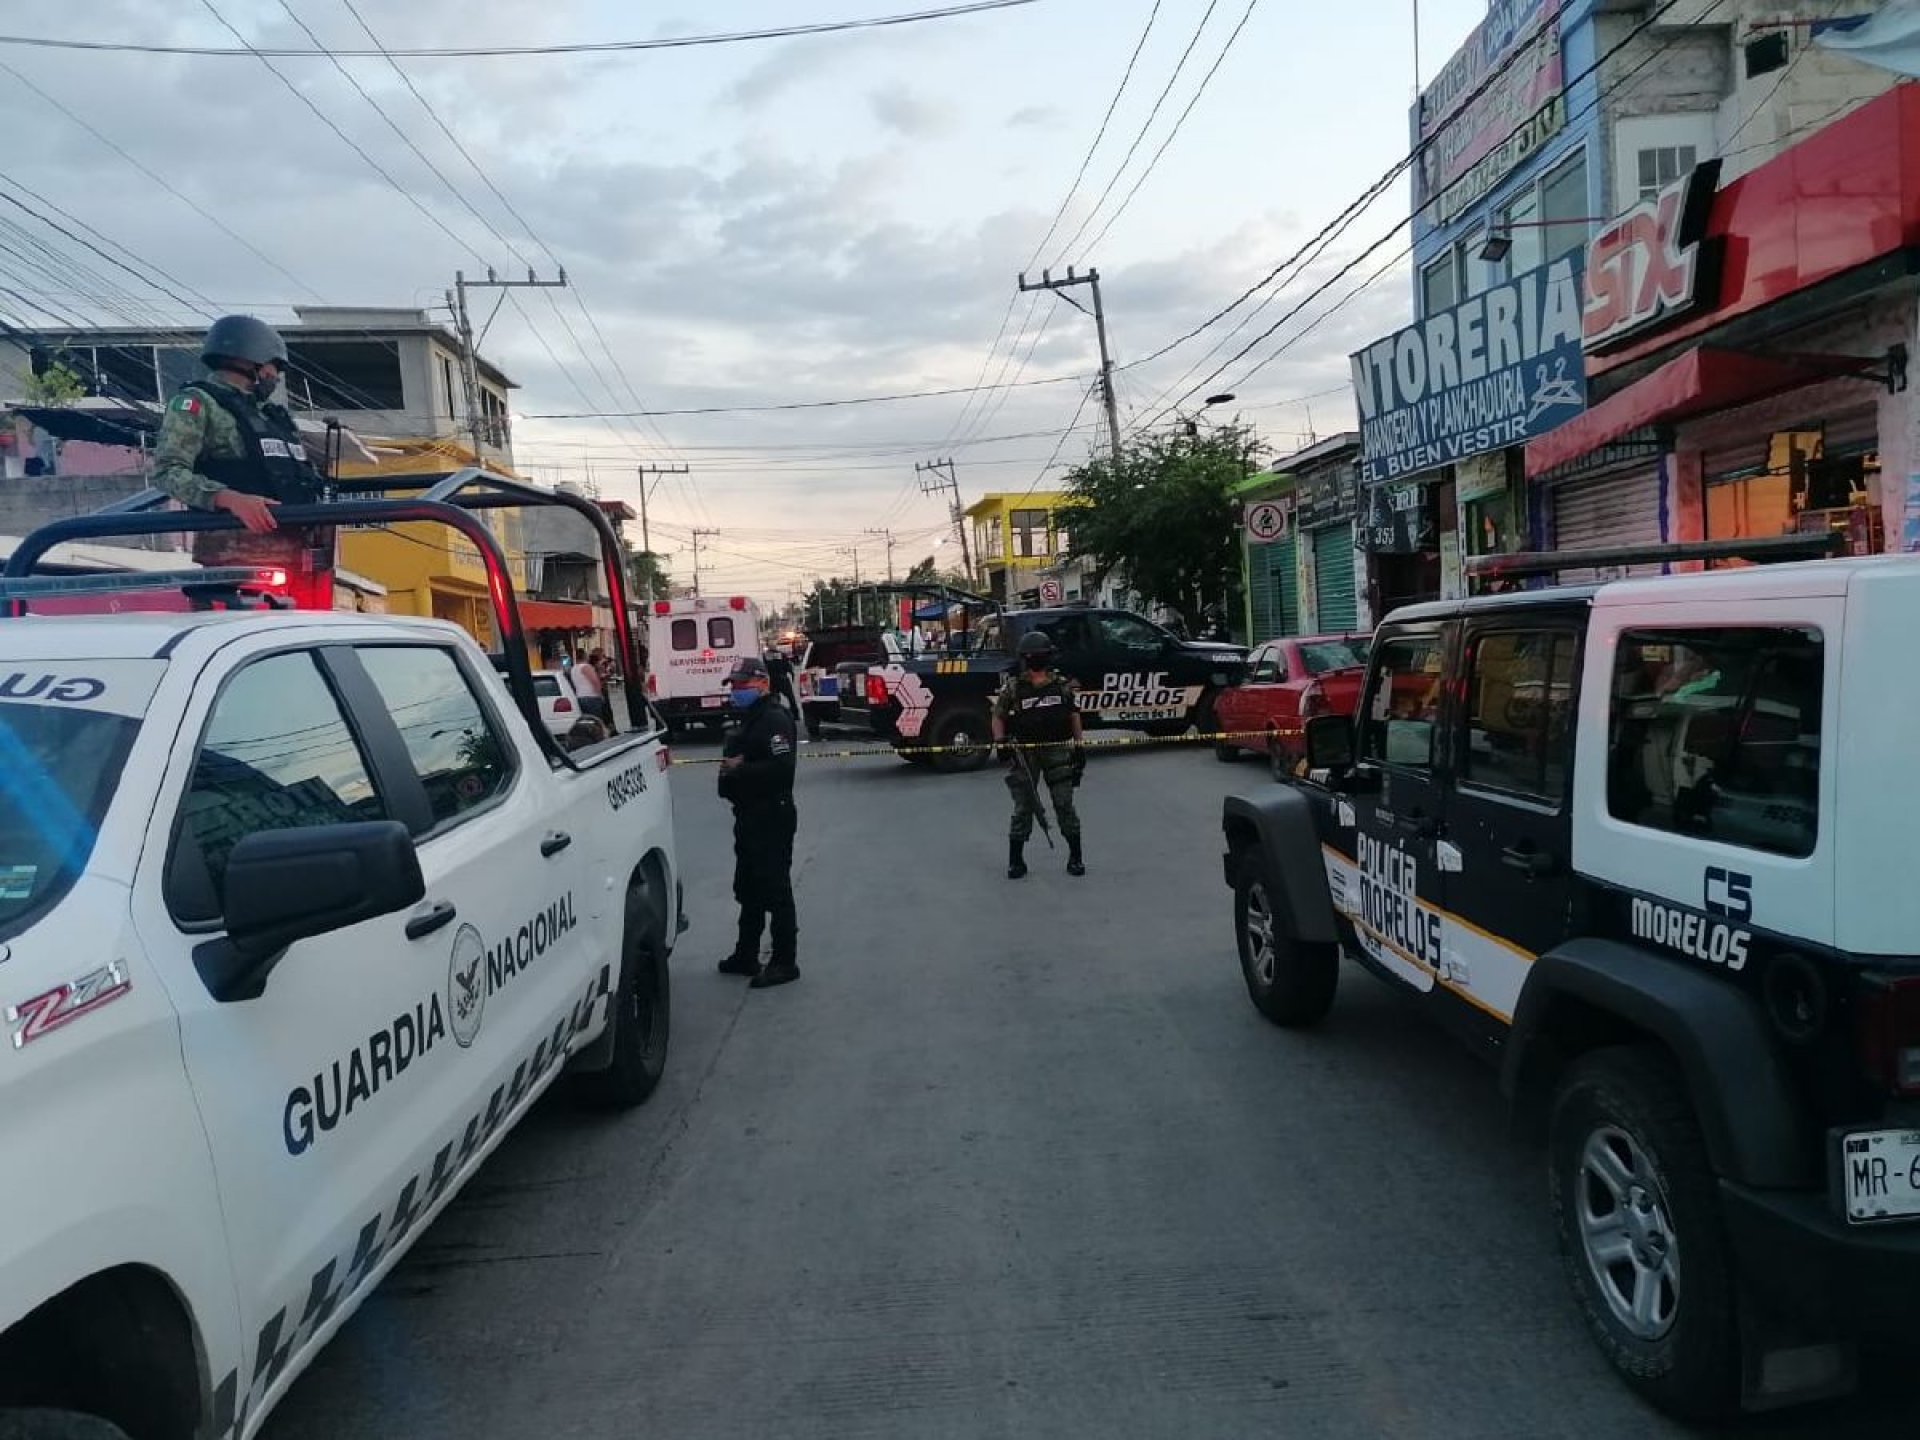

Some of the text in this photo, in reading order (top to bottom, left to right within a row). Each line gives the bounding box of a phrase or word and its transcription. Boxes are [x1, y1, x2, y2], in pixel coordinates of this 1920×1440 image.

[1583, 190, 1690, 340] SIX
[1362, 460, 1384, 482] EL
[1388, 444, 1441, 475] BUEN
[1445, 416, 1527, 457] VESTIR
[1079, 688, 1187, 709] MORELOS
[1704, 866, 1753, 924] C5
[1632, 897, 1751, 971] MORELOS
[283, 890, 577, 1156] GUARDIA NACIONAL
